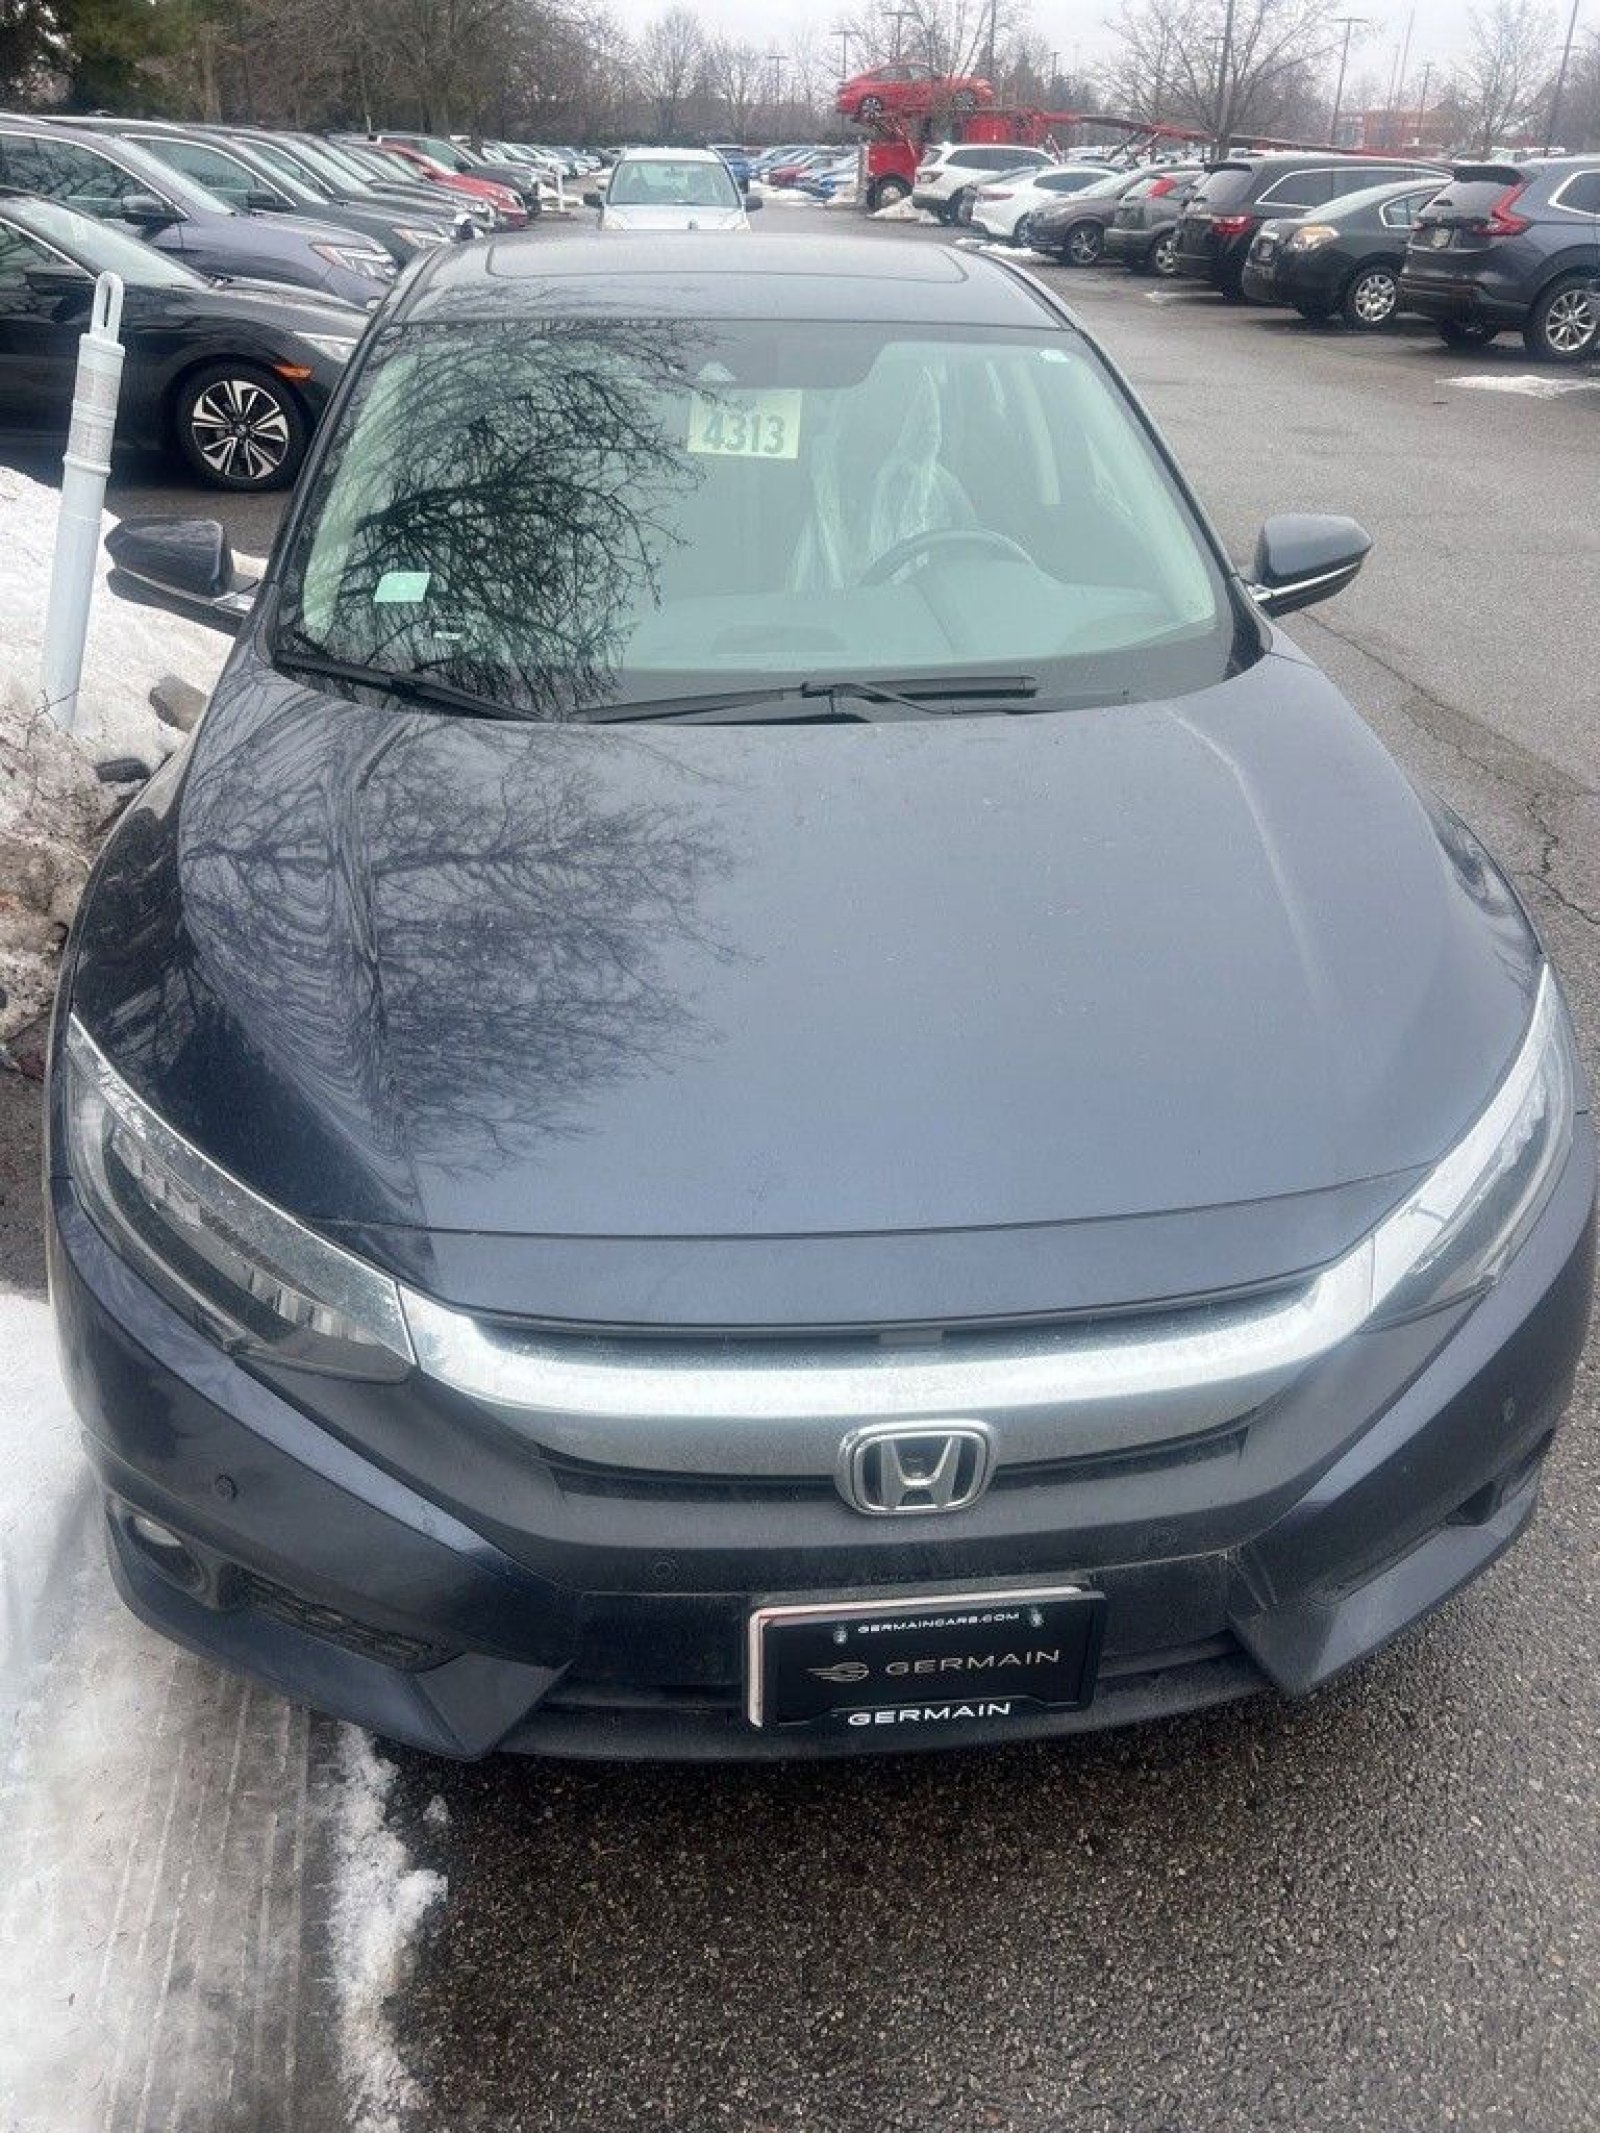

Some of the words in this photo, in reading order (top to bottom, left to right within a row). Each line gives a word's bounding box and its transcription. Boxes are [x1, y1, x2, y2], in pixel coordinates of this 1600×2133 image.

[703, 414, 785, 454] 4313
[857, 1612, 1020, 1634] GERMAINCARS.COM
[885, 1649, 1060, 1676] GERMAIN
[847, 1702, 1012, 1726] GERMAIN
